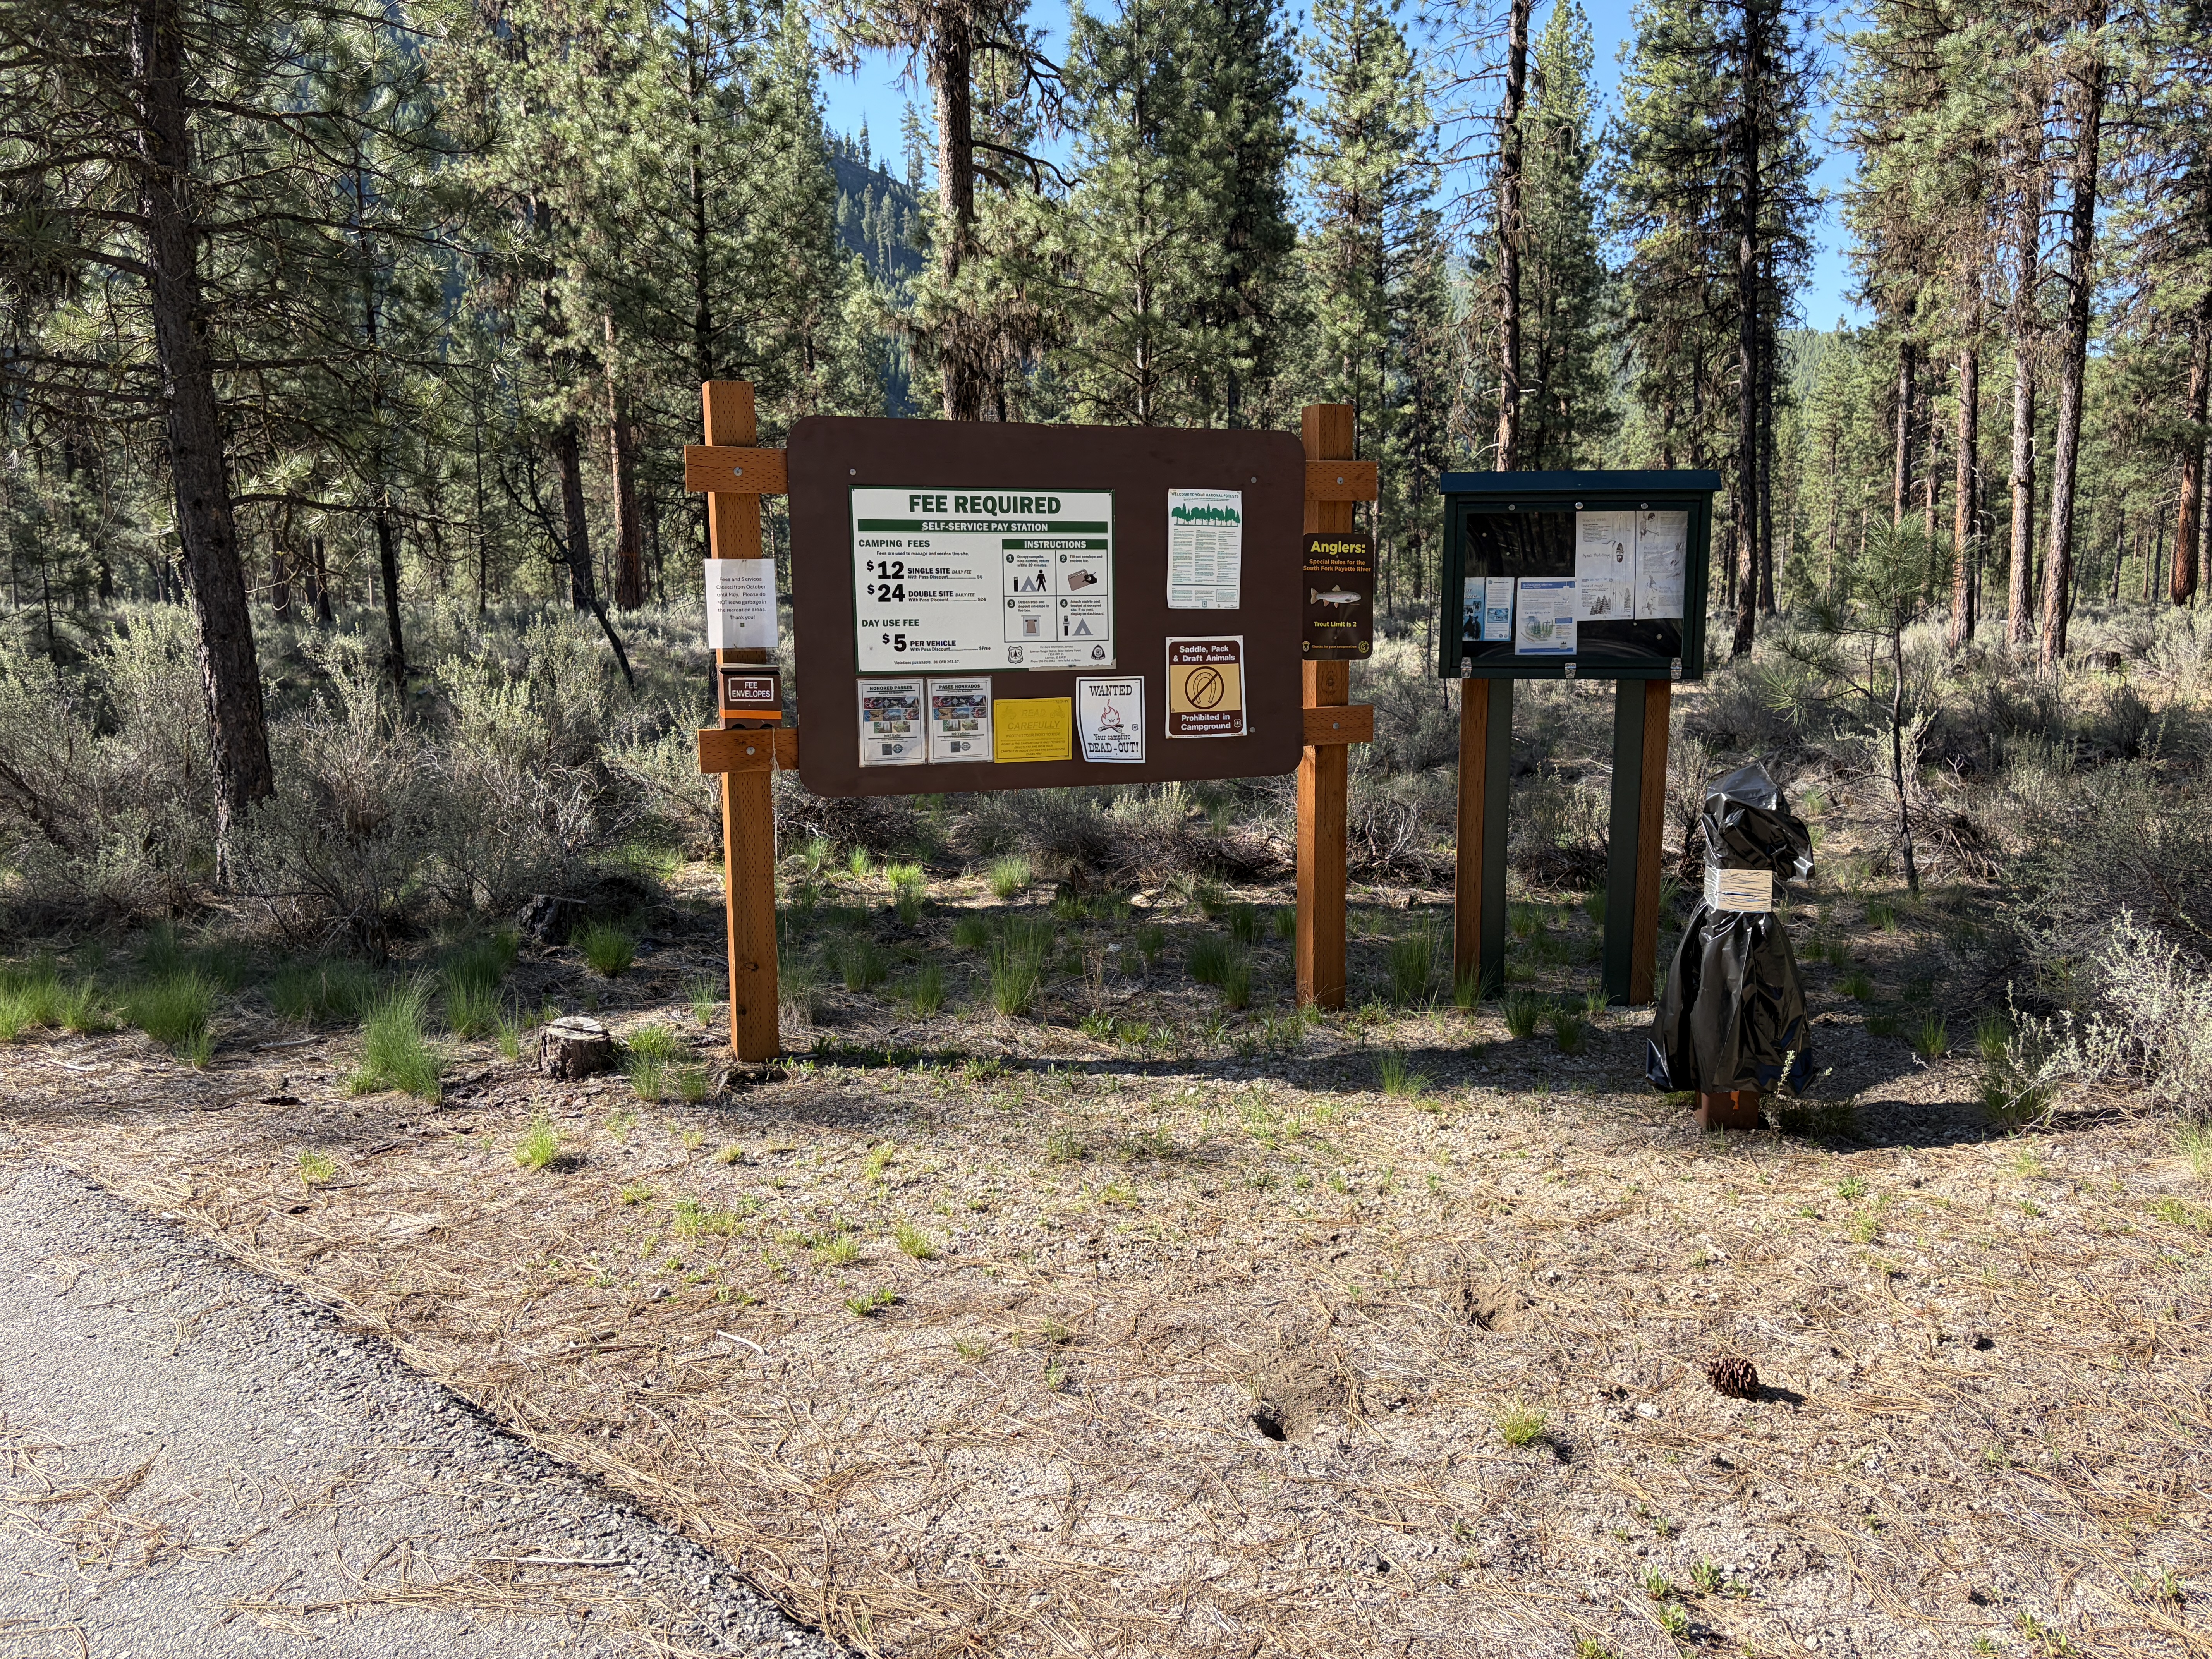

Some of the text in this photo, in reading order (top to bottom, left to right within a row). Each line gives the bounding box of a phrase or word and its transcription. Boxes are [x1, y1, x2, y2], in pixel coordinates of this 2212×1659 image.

[909, 495, 1061, 516] FEE REQUIRED
[922, 522, 1048, 531] SELF-SERVICE PAY STATION
[1310, 541, 1365, 555] Anglers:
[1179, 646, 1208, 654] Saddle,
[1089, 685, 1132, 696] WANTED
[1008, 720, 1060, 730] CAREFULLY
[1181, 722, 1231, 731] Campground
[1108, 733, 1131, 742] campfire
